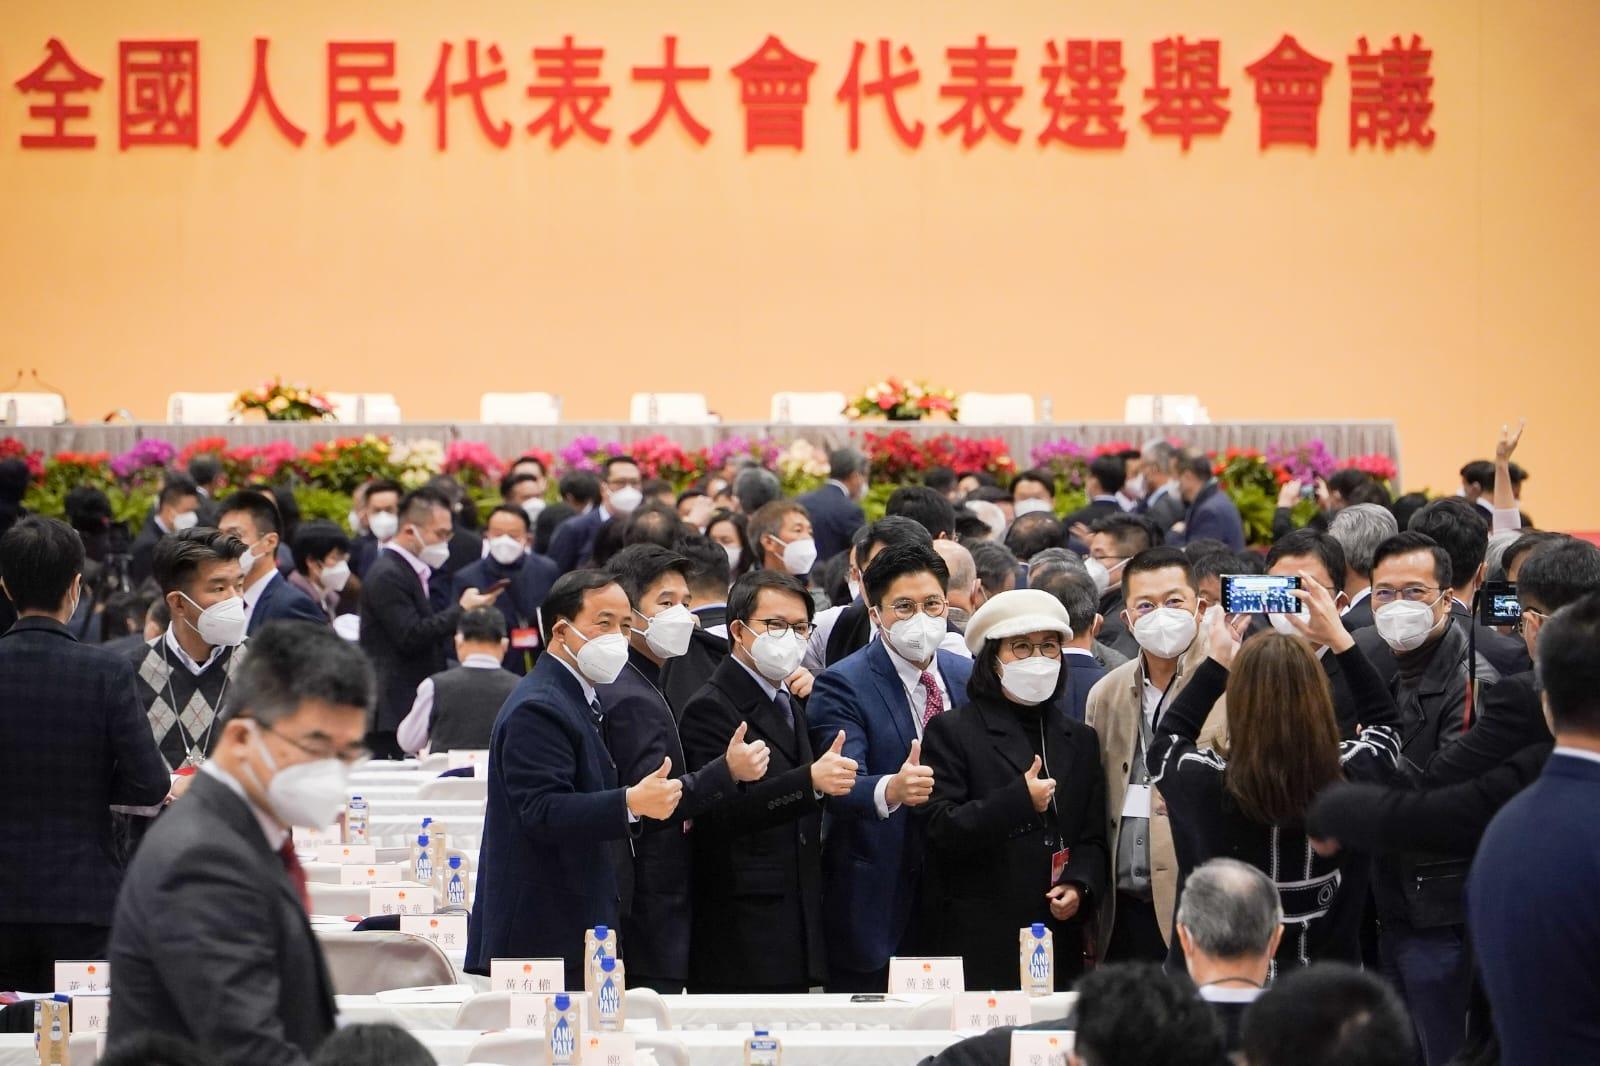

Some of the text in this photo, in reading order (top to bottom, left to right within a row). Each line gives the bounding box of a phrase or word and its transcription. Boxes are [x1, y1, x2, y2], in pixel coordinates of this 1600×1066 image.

[14, 33, 1437, 154] 全國人民代表大會代表選舉會議
[599, 986, 620, 1000] LAND
[598, 999, 620, 1014] PARK
[552, 1026, 574, 1041] LAND
[552, 1040, 574, 1056] PARK
